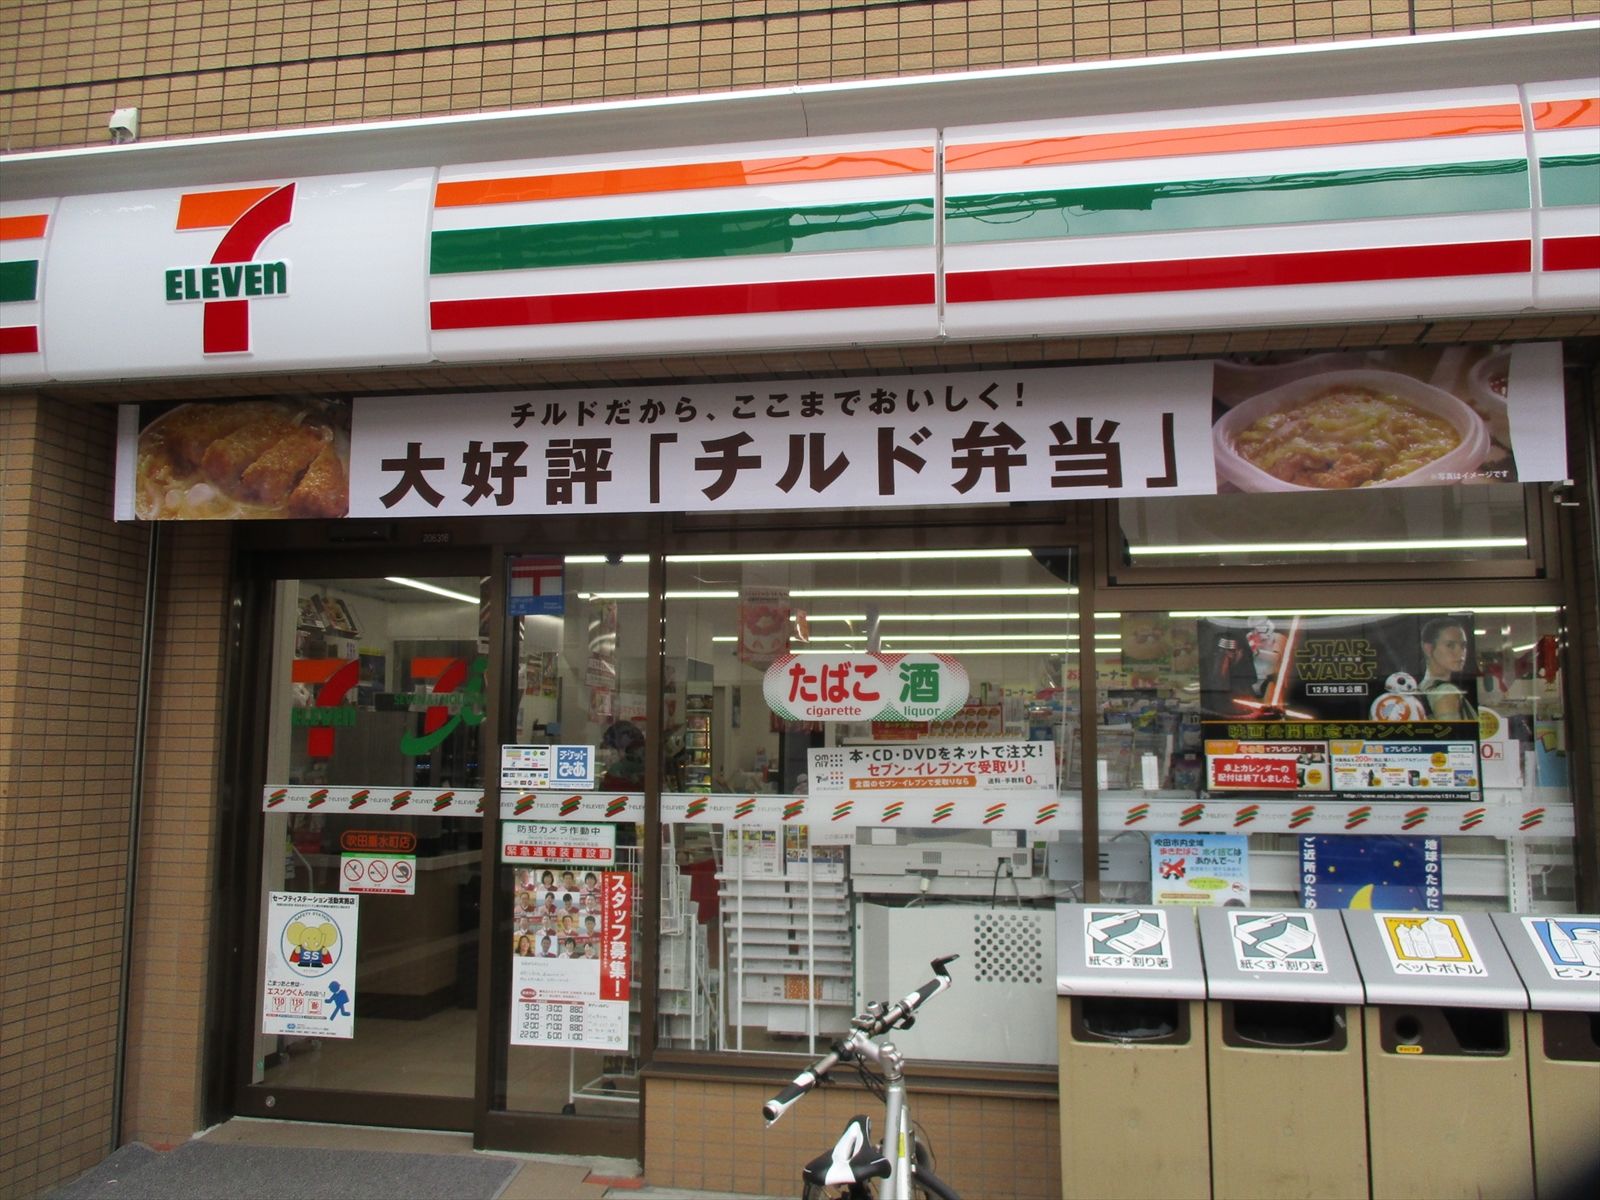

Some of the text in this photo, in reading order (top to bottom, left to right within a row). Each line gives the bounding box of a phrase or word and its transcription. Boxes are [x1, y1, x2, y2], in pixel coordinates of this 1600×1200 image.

[511, 382, 1024, 427] チルドだから、ここまでおいしく!
[379, 412, 1178, 508] 大好評「チルド弁当」
[1295, 639, 1376, 657] STAR
[1296, 662, 1377, 680] WARS
[788, 661, 940, 703] たばこ 酒
[806, 704, 941, 718] cigarette liquor
[849, 745, 1044, 763] 本・CD・DVDをネットで注文!
[1223, 763, 1289, 773] 卓上カレンダーの
[517, 824, 601, 835] 防犯カメラ作動中
[609, 874, 627, 996] スタッフ募集!
[303, 951, 320, 960] SS
[1088, 955, 1169, 968] 紙くず・割り箸
[1240, 959, 1324, 972] 紙くず・割り箸
[1396, 962, 1483, 975] ペットボトル
